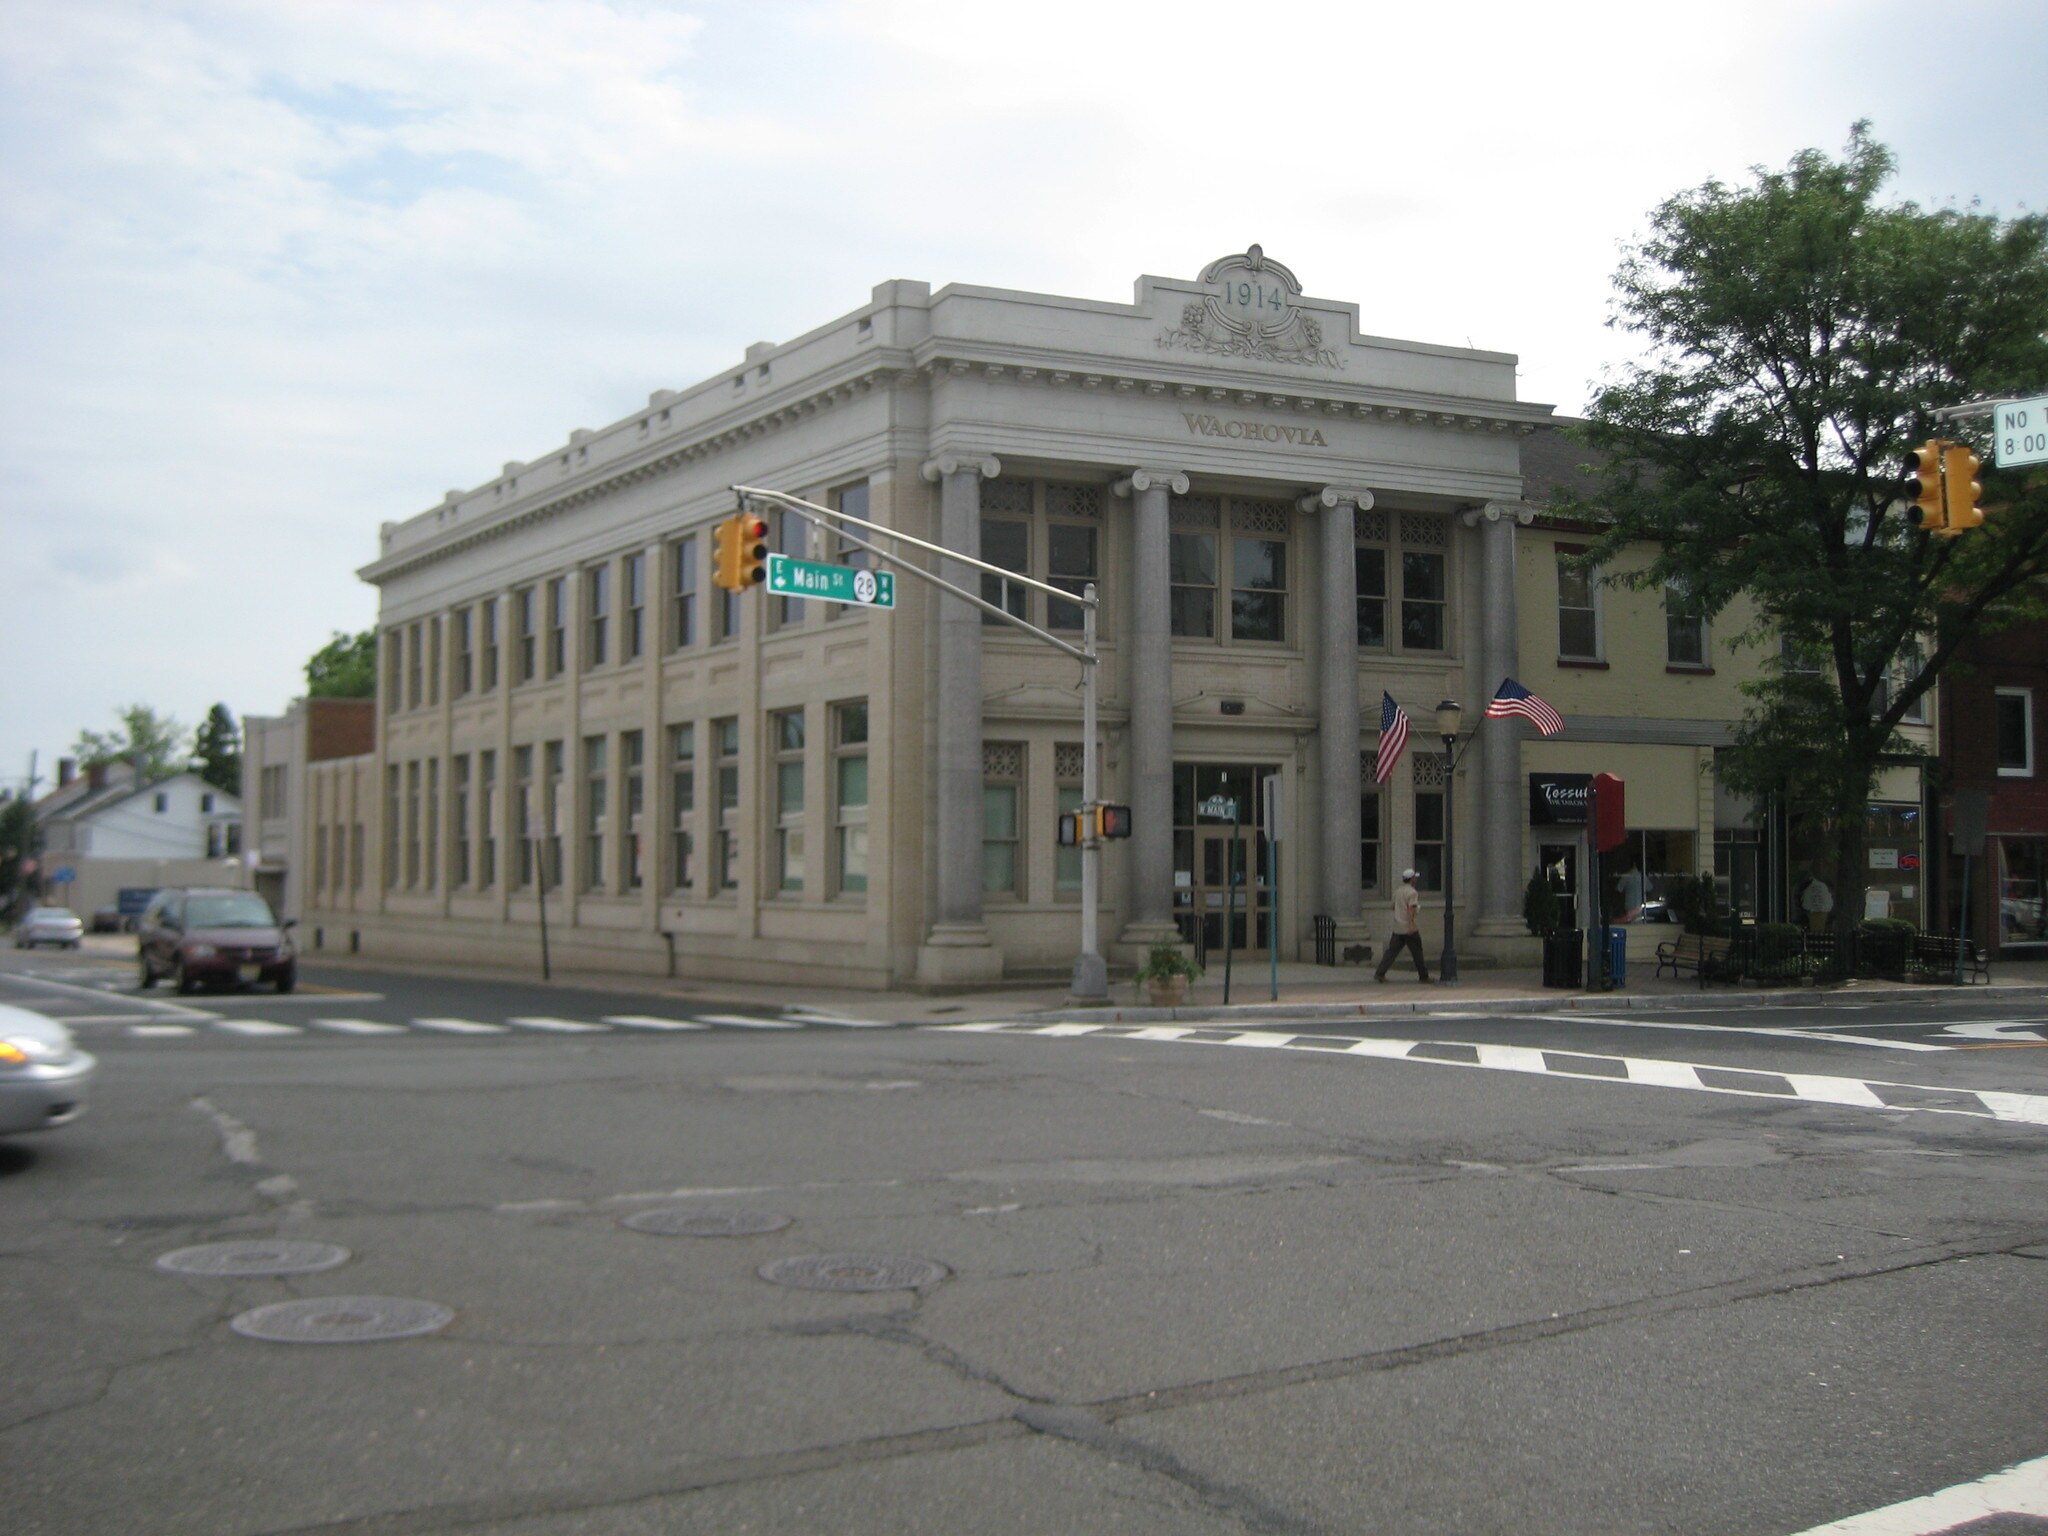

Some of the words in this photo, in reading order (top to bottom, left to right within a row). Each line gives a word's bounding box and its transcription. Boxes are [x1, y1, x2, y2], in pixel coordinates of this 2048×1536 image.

[1226, 281, 1282, 311] 1914
[1181, 412, 1328, 447] WACHOVIA
[2005, 411, 2027, 430] NO
[2005, 433, 2045, 455] 8:00
[776, 560, 783, 574] E
[793, 567, 829, 591] Main
[832, 573, 844, 586] St
[857, 577, 874, 596] 28
[881, 576, 889, 588] W
